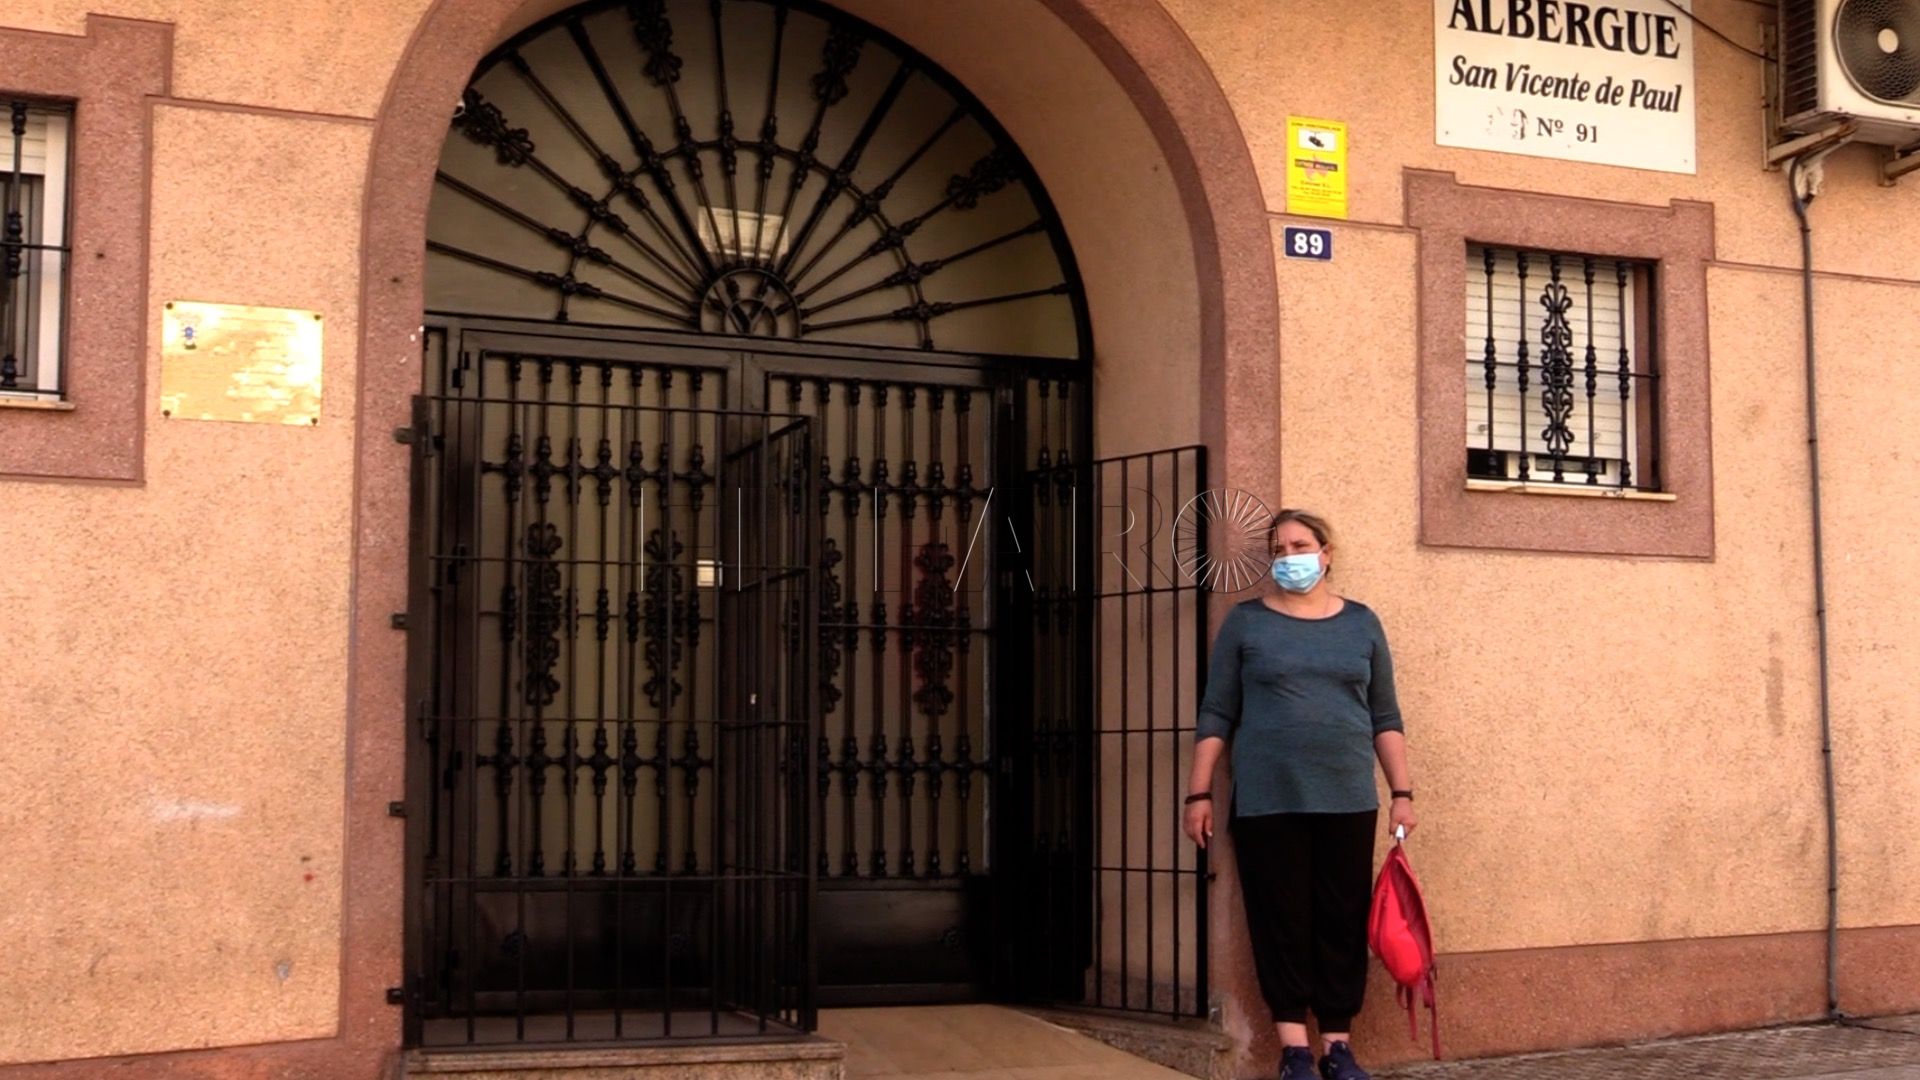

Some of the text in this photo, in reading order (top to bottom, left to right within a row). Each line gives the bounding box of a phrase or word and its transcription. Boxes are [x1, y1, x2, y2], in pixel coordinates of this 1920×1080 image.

[1447, 0, 1681, 59] ALBERGUE
[1449, 55, 1683, 113] San Vicente de Paul
[1576, 123, 1598, 143] 91
[1294, 232, 1324, 255] 89
